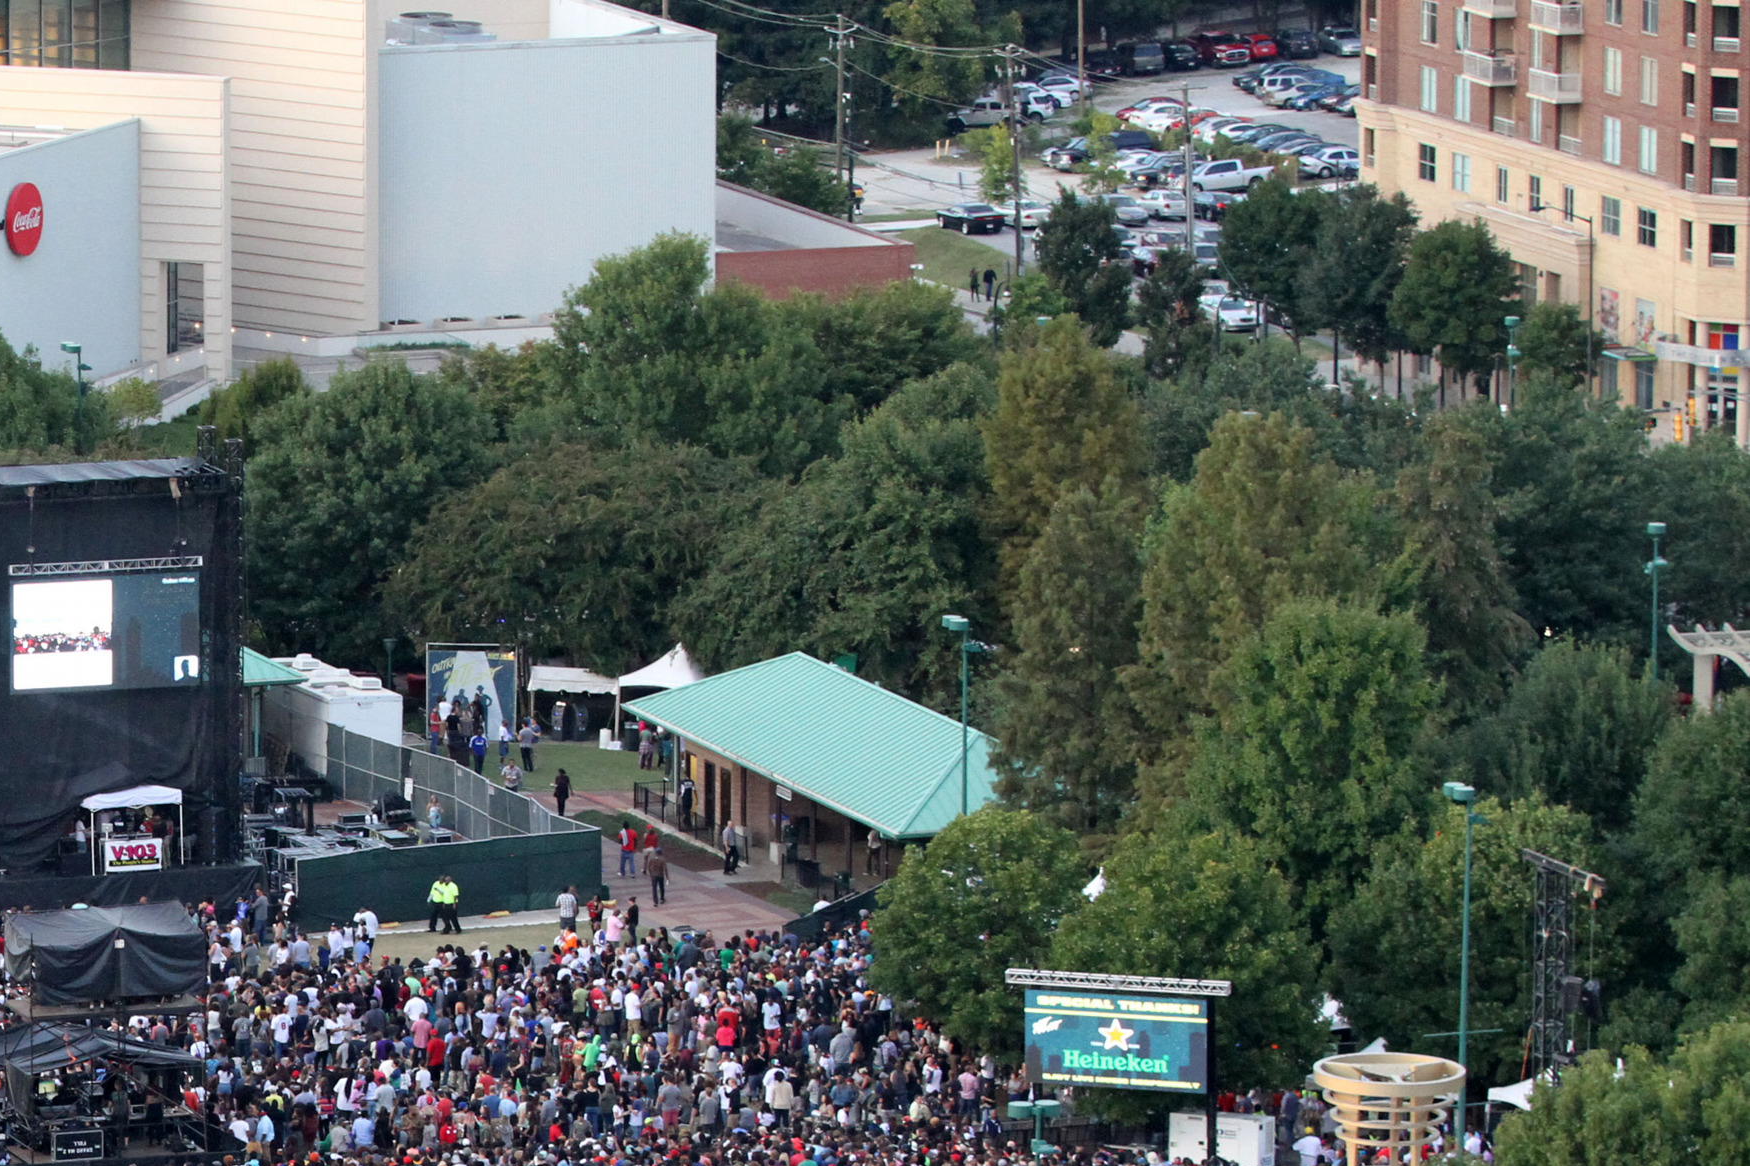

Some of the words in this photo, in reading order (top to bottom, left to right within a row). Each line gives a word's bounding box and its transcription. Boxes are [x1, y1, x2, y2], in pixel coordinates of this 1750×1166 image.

[13, 206, 41, 233] Coca-Cola
[111, 843, 156, 860] V-103
[1037, 995, 1115, 1010] SPECIAL
[1117, 1000, 1200, 1015] THANKS!
[1062, 1049, 1169, 1074] Heineken
